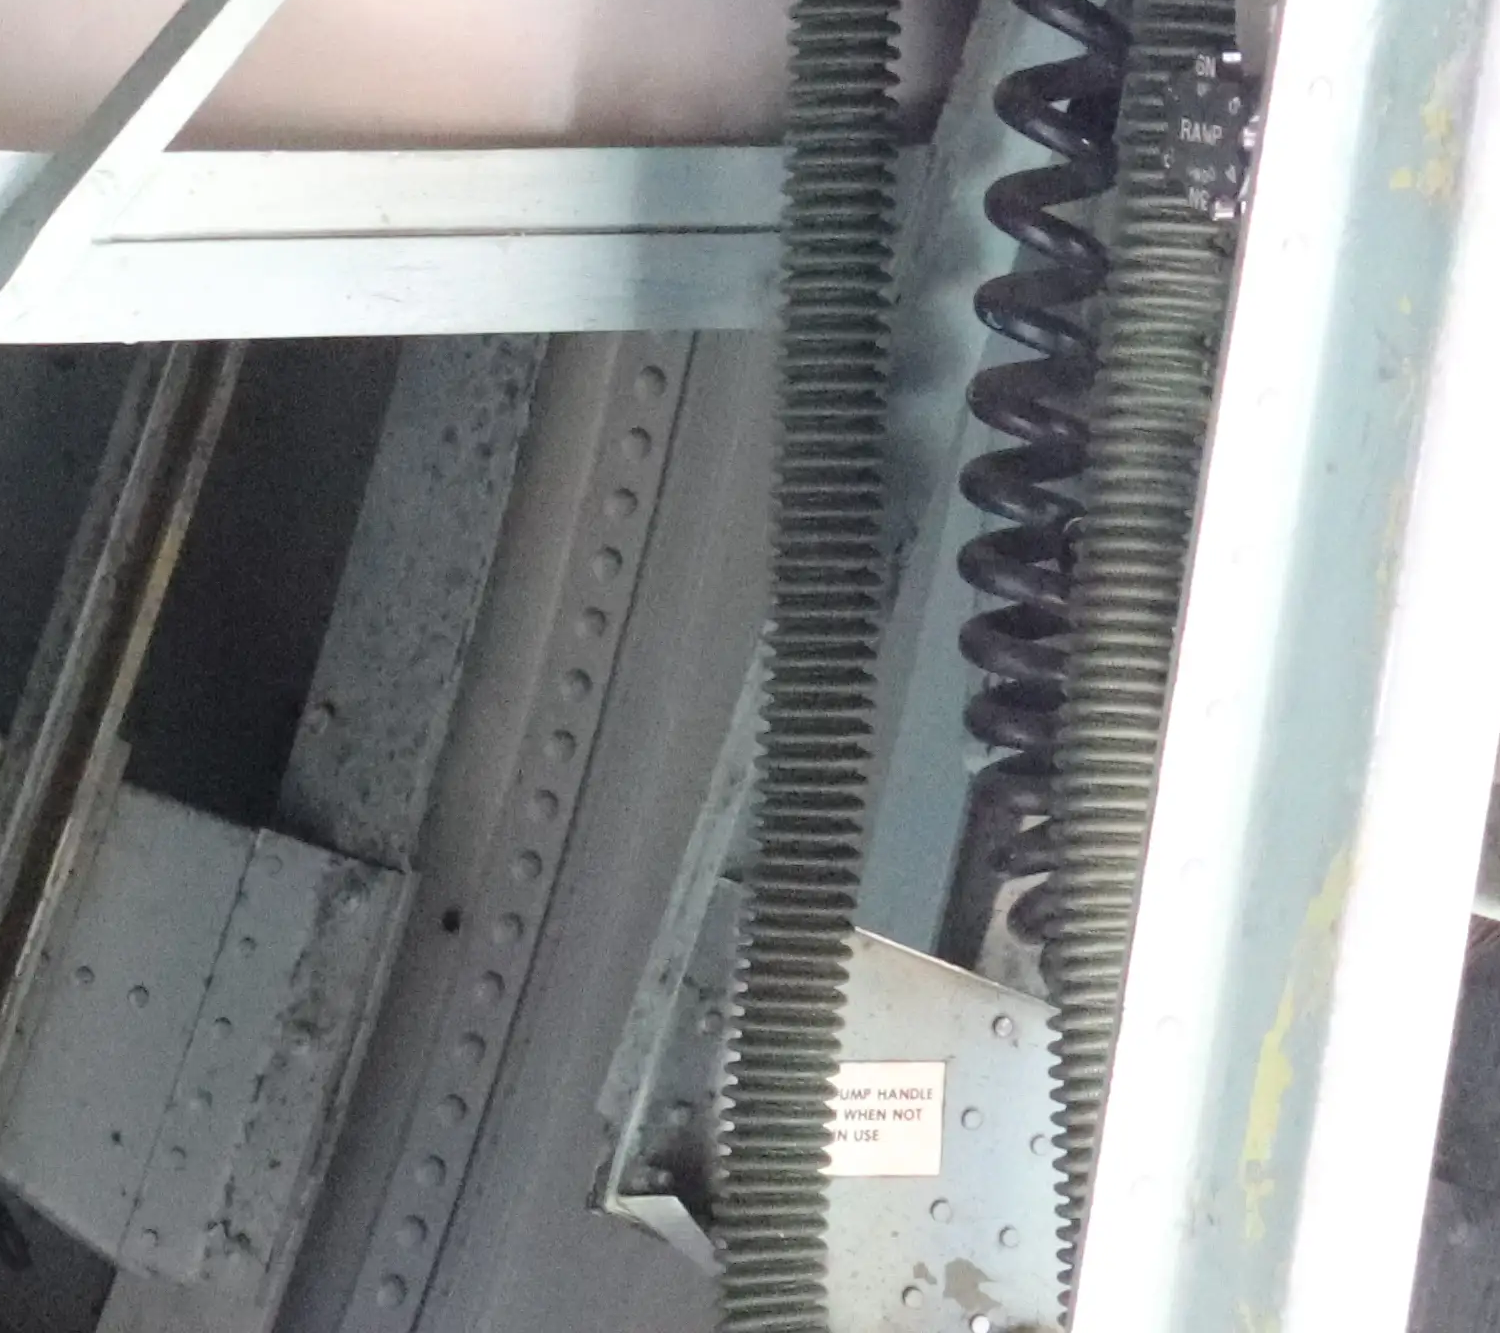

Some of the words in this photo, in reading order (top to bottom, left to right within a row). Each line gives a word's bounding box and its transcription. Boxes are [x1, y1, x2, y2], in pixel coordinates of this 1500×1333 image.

[1181, 117, 1222, 146] RAMP
[836, 1088, 871, 1101] UMP
[877, 1088, 933, 1101] HANDLE
[844, 1108, 886, 1121] WHEN
[893, 1108, 922, 1121] NOT
[854, 1129, 880, 1143] USE
